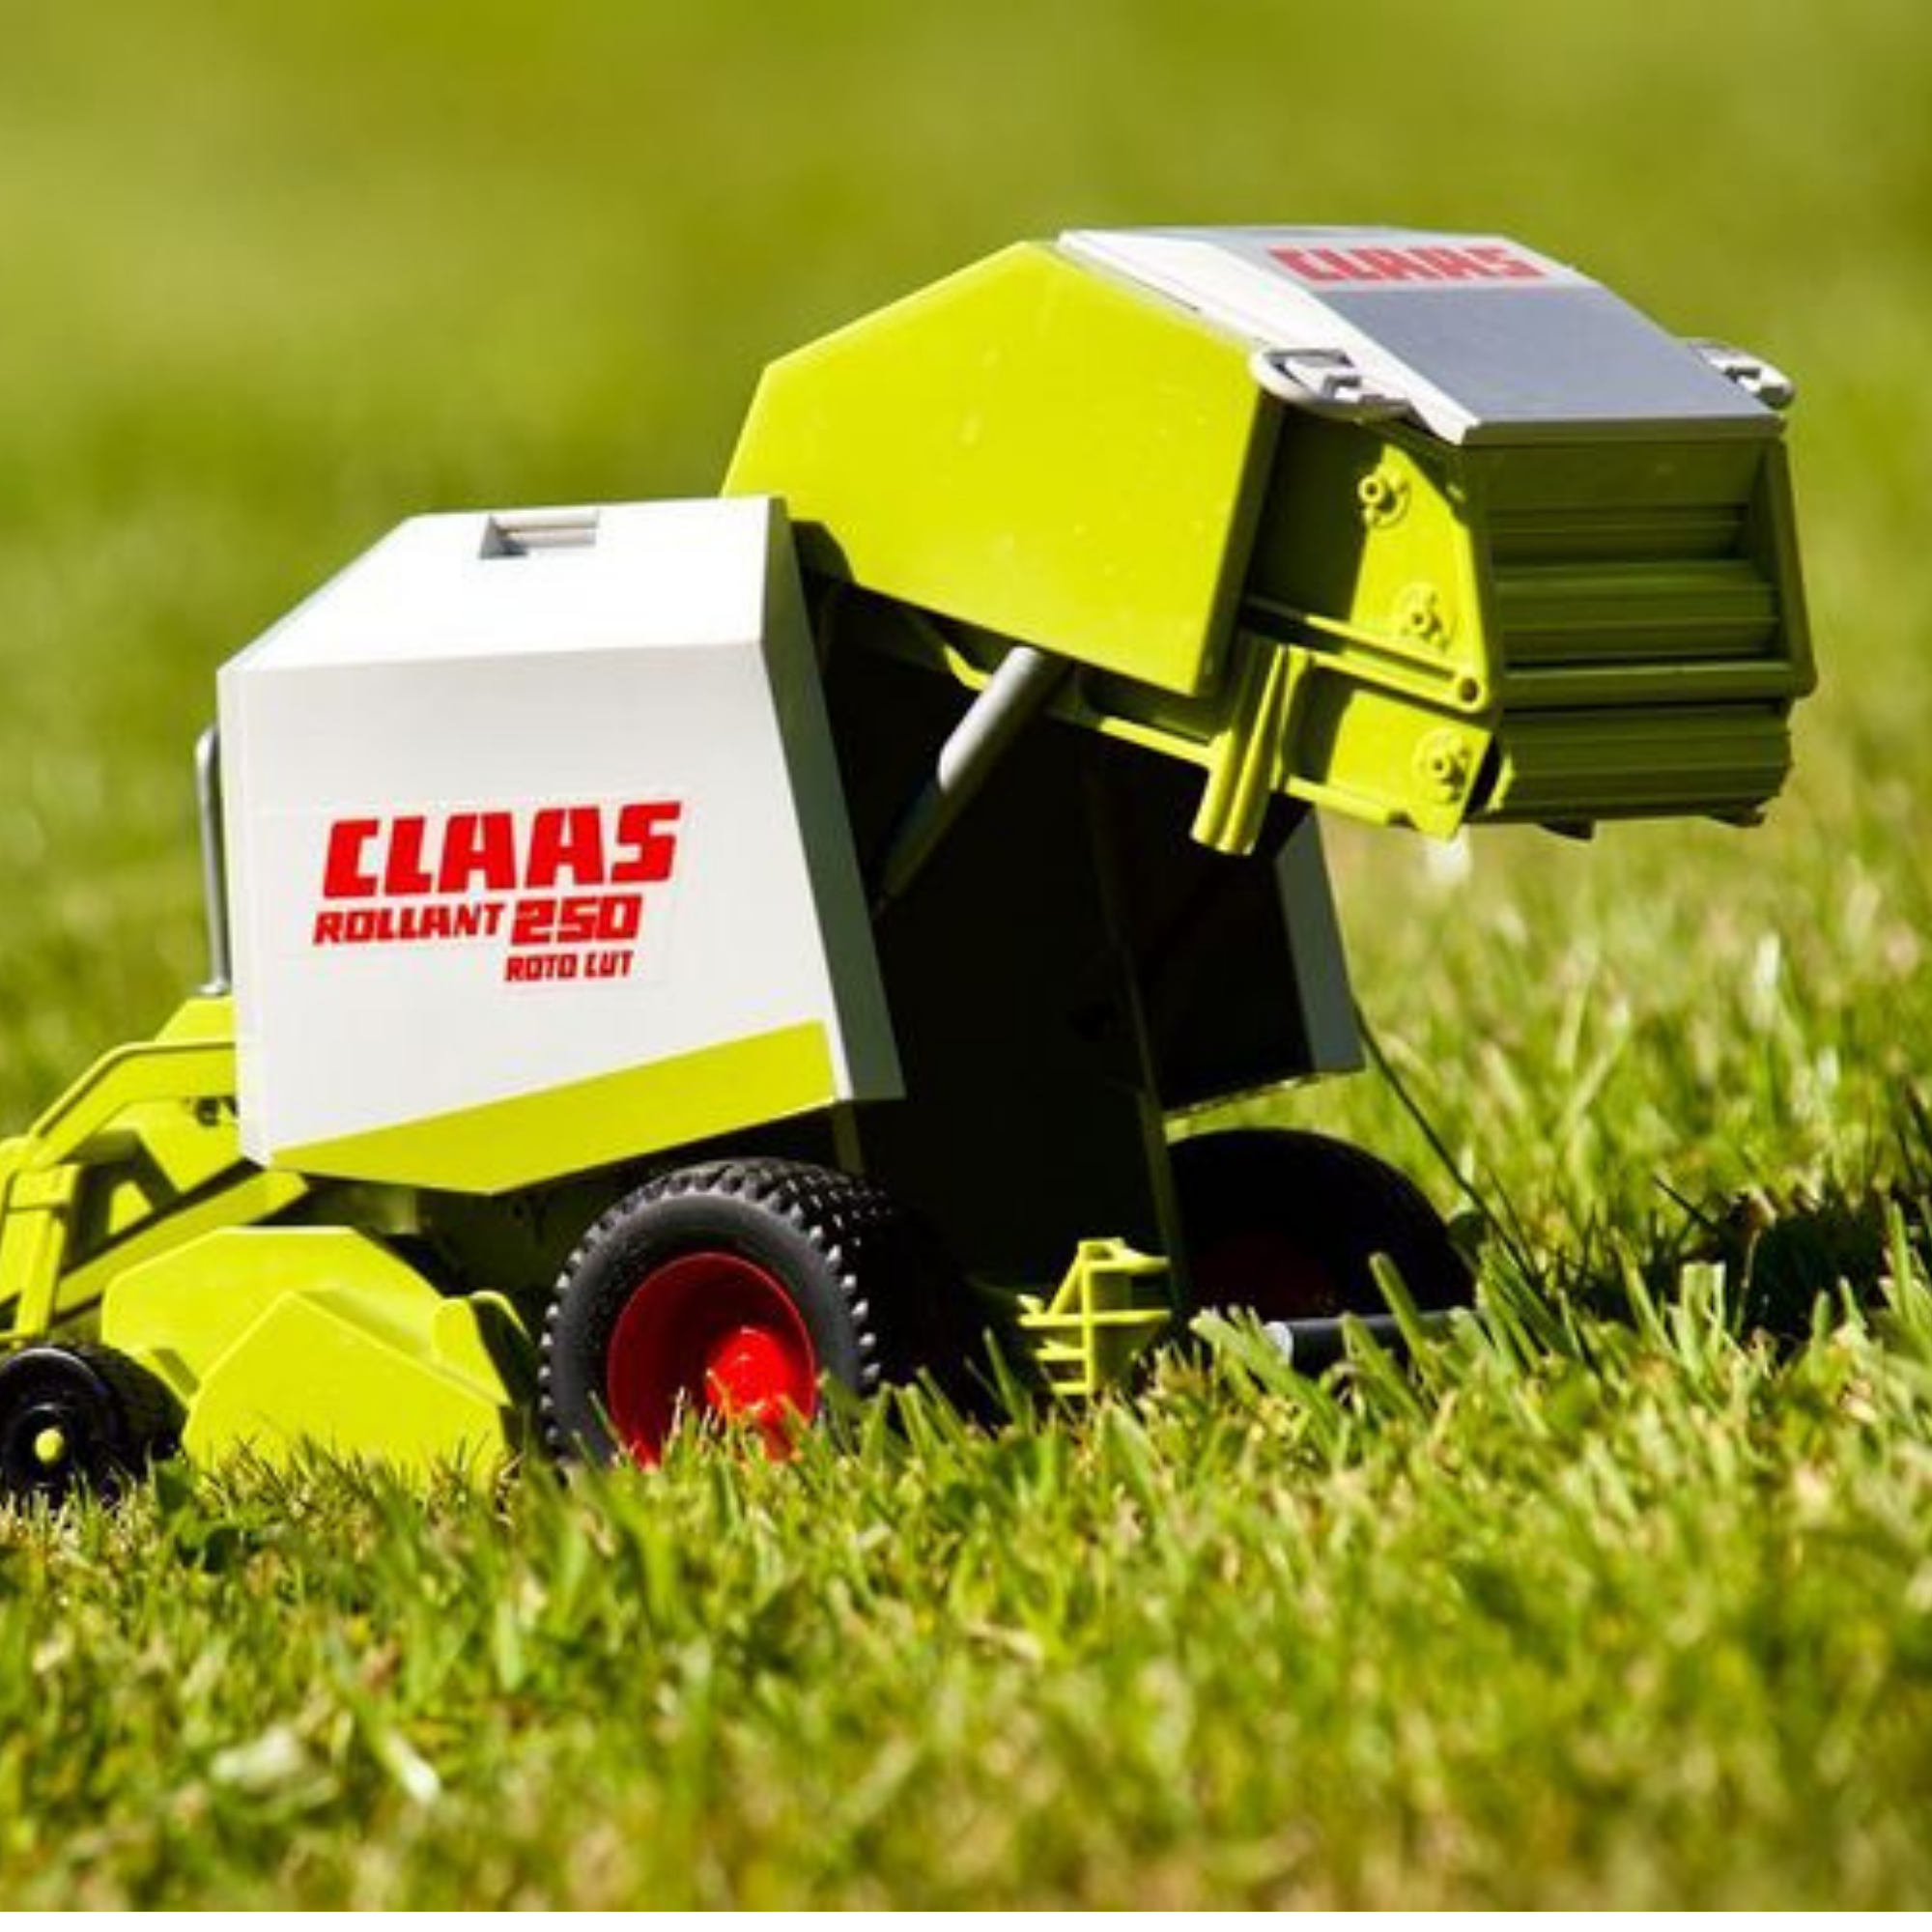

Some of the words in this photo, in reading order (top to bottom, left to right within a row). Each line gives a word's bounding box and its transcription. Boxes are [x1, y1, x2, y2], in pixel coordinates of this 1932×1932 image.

[1267, 247, 1547, 281] CLAAS
[323, 801, 682, 899] CLAAS
[313, 902, 505, 946] ROLLANT
[510, 894, 643, 947] 250
[504, 952, 578, 982] ROTO
[582, 951, 634, 980] CUT
